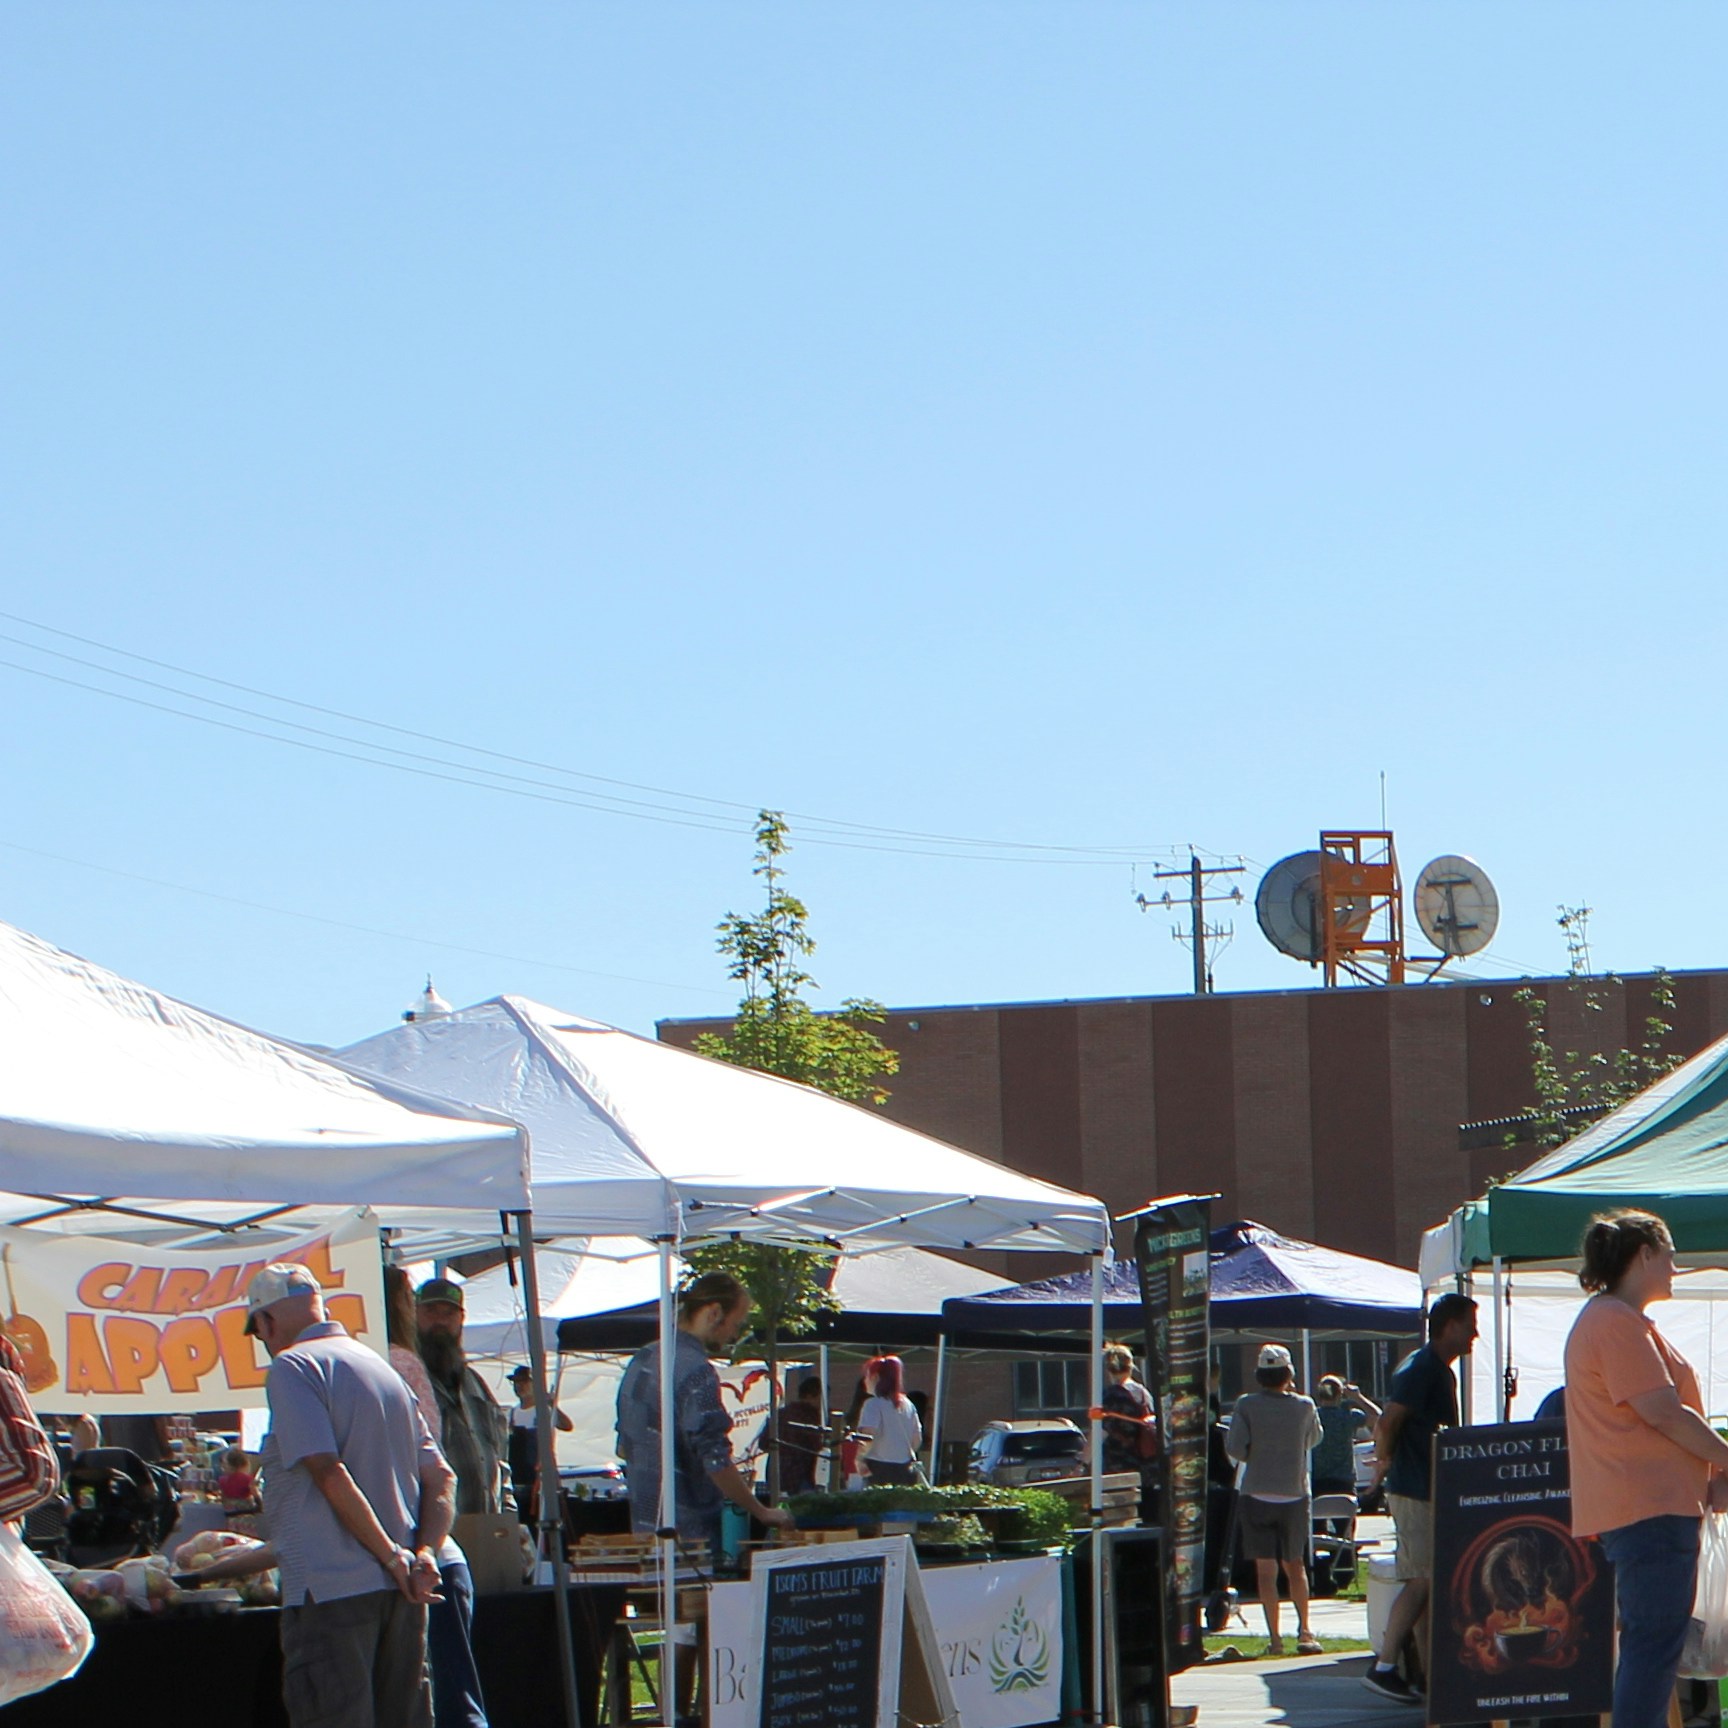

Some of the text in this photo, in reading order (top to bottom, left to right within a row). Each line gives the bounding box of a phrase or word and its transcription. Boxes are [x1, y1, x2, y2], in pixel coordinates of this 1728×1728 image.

[77, 1234, 345, 1317] CARAL
[66, 1292, 368, 1395] APPL
[1441, 1440, 1533, 1461] DRAGON
[1497, 1462, 1551, 1479] CHAI
[812, 1569, 848, 1591] FRUIT
